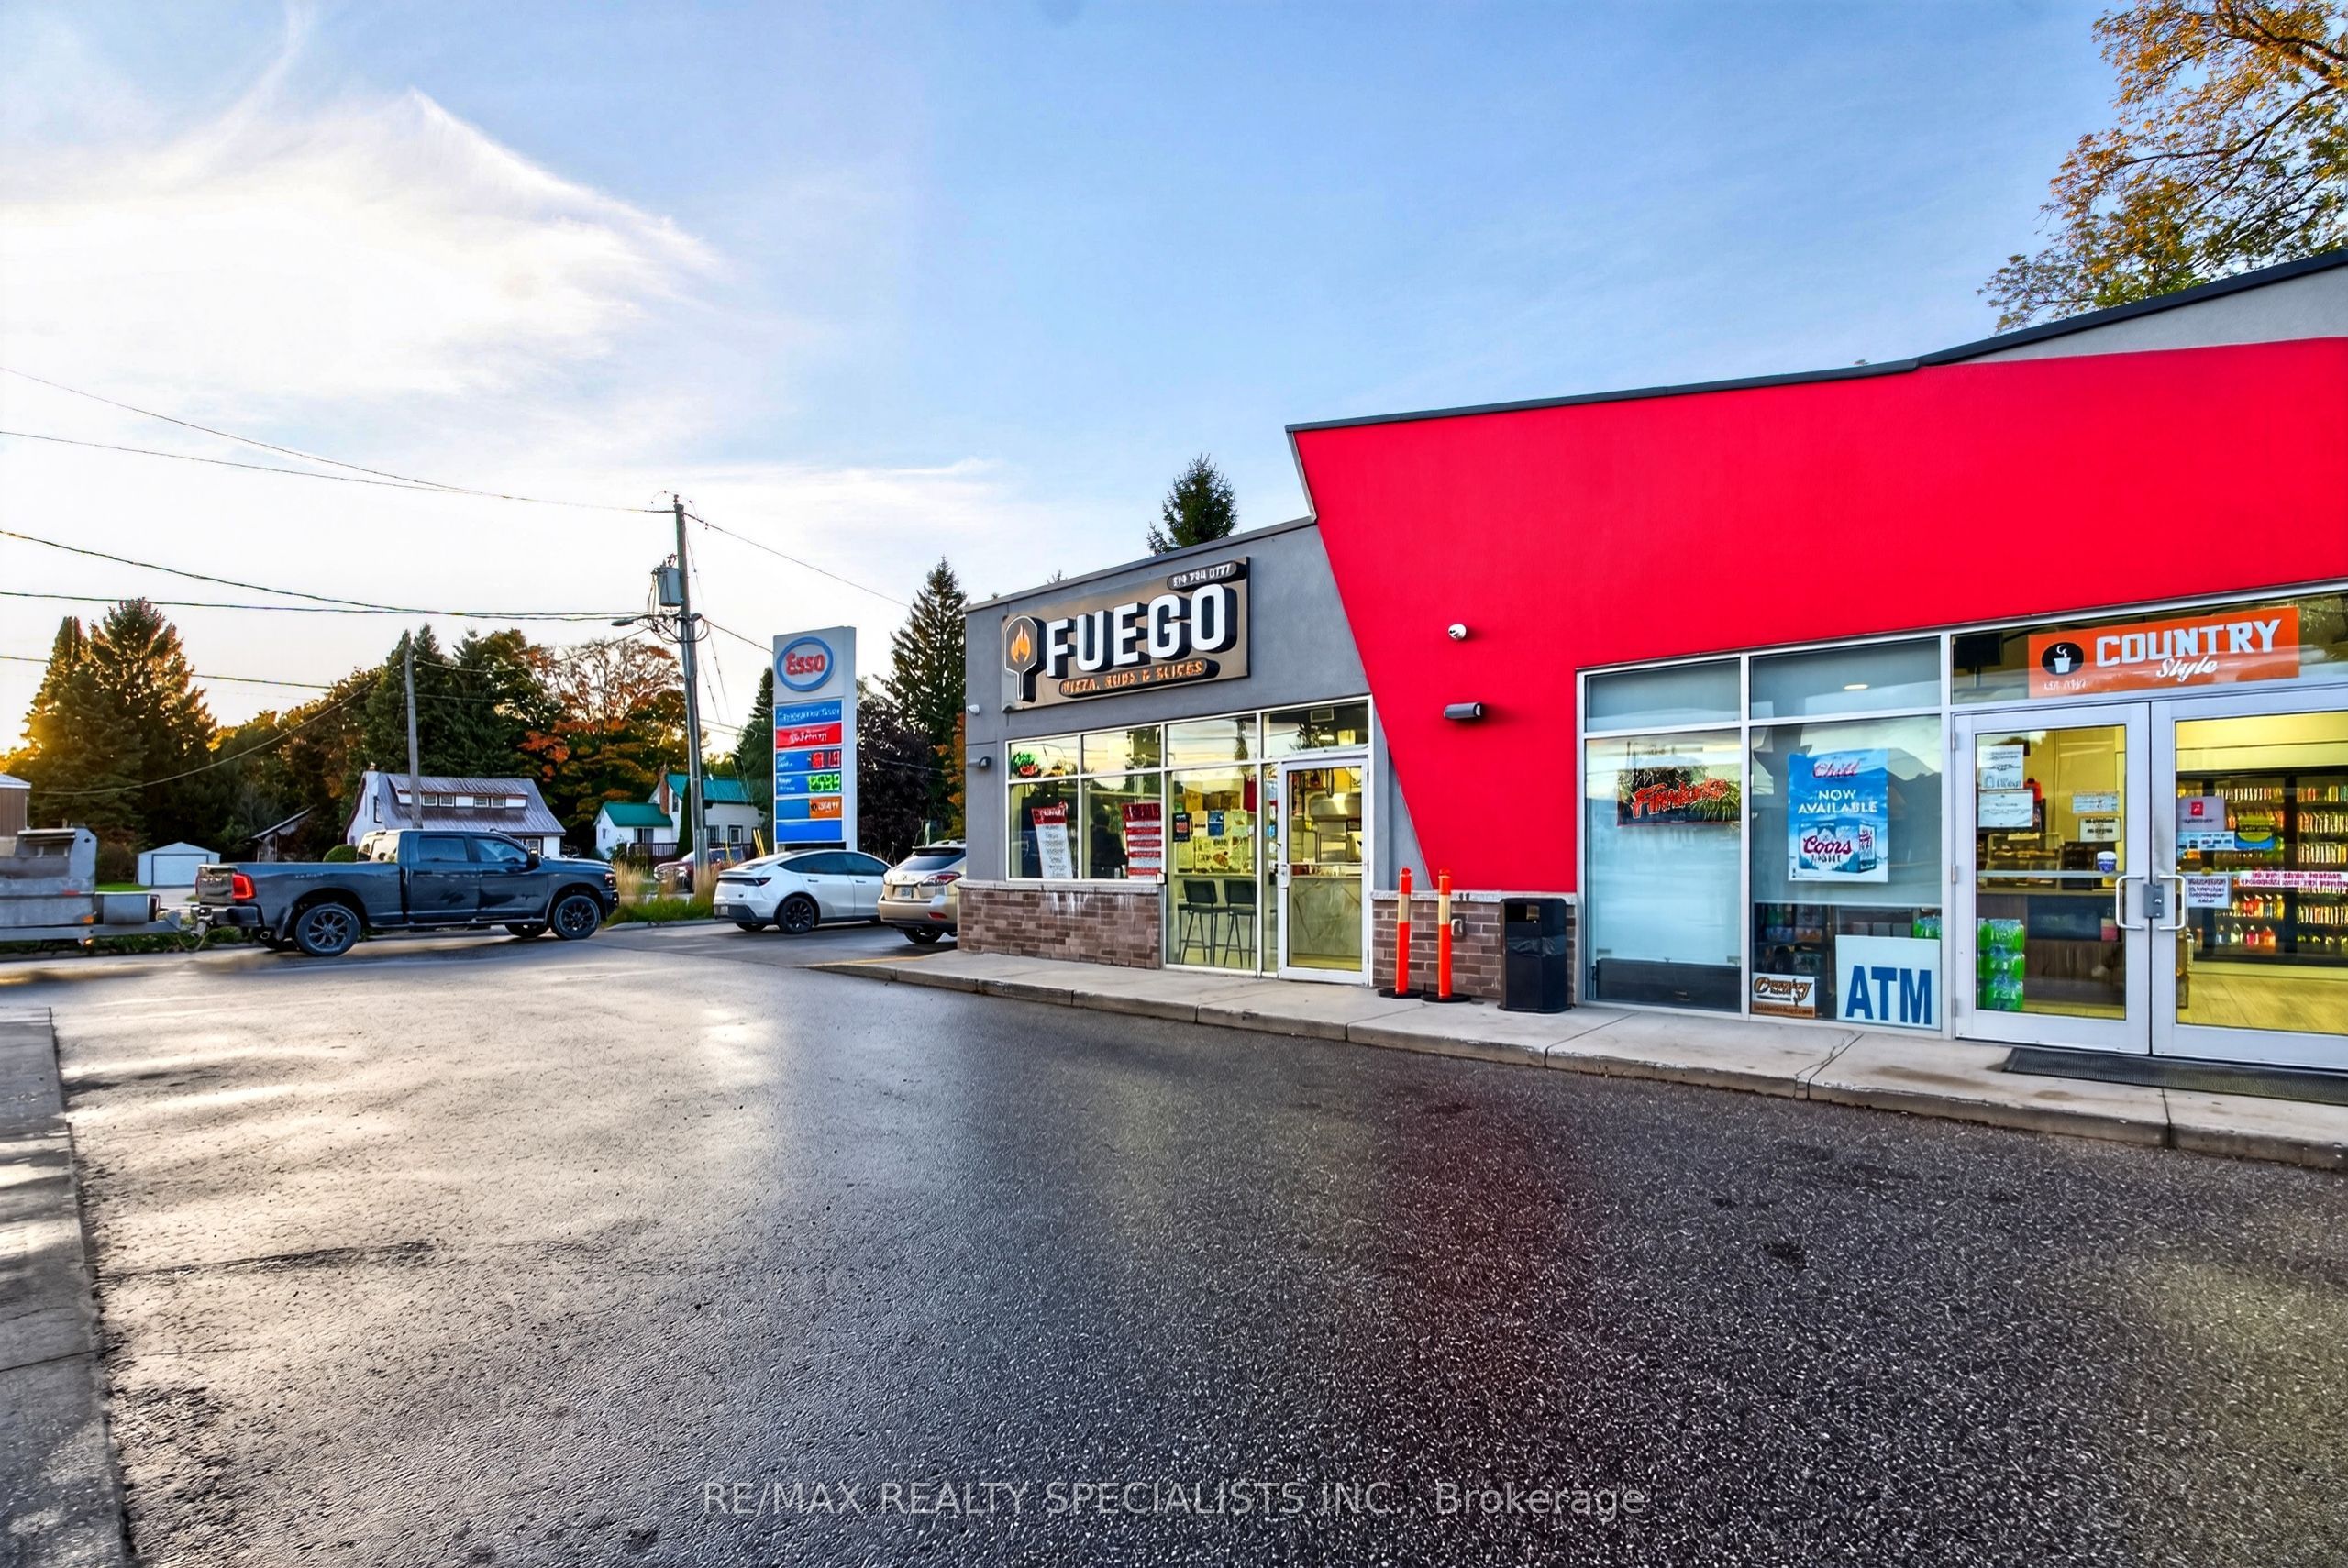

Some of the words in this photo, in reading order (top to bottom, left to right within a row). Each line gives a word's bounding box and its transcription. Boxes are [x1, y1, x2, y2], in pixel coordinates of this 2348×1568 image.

[1046, 584, 1225, 678] FUEGO
[2096, 619, 2281, 667] COUNTRY
[785, 652, 825, 676] Esso
[2156, 656, 2219, 682] Style
[1798, 801, 1878, 814] AVAILABLE
[1818, 789, 1856, 801] NOW
[1803, 835, 1853, 855] Coors
[1845, 965, 1932, 1025] ATM
